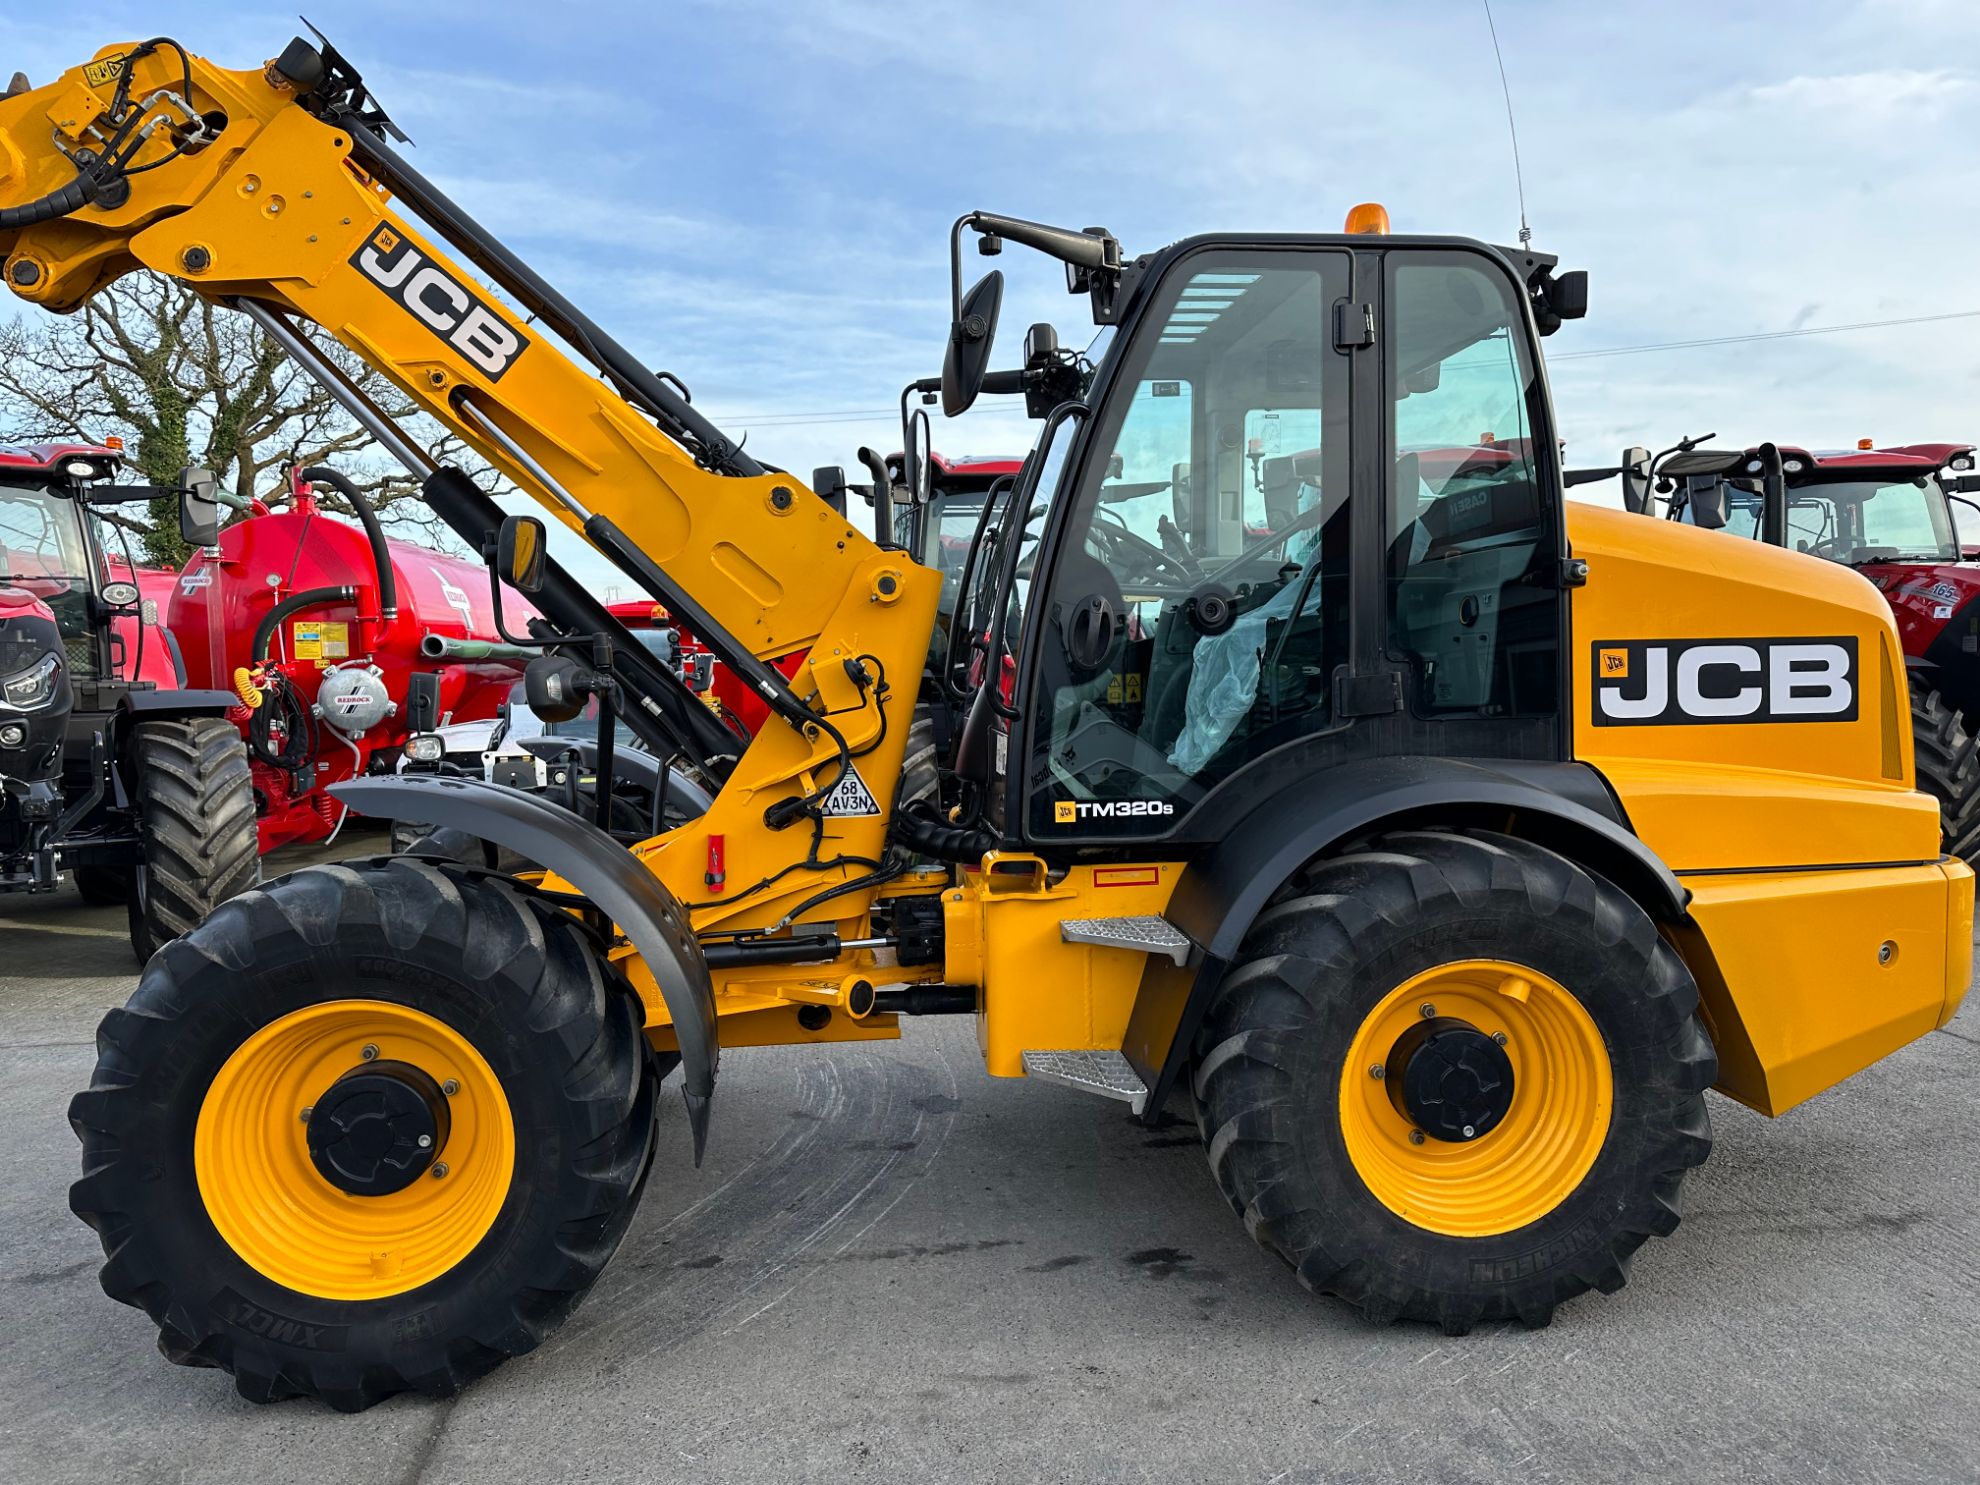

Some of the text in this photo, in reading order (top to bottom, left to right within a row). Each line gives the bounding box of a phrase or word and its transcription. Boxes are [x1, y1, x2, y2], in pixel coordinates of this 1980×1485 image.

[360, 246, 518, 373] JCB
[1932, 583, 1956, 598] 165
[1607, 655, 1624, 670] JCB
[1600, 644, 1852, 719] JCB
[841, 781, 857, 795] 68
[832, 796, 868, 811] AV3N
[236, 1303, 325, 1348] XMCL
